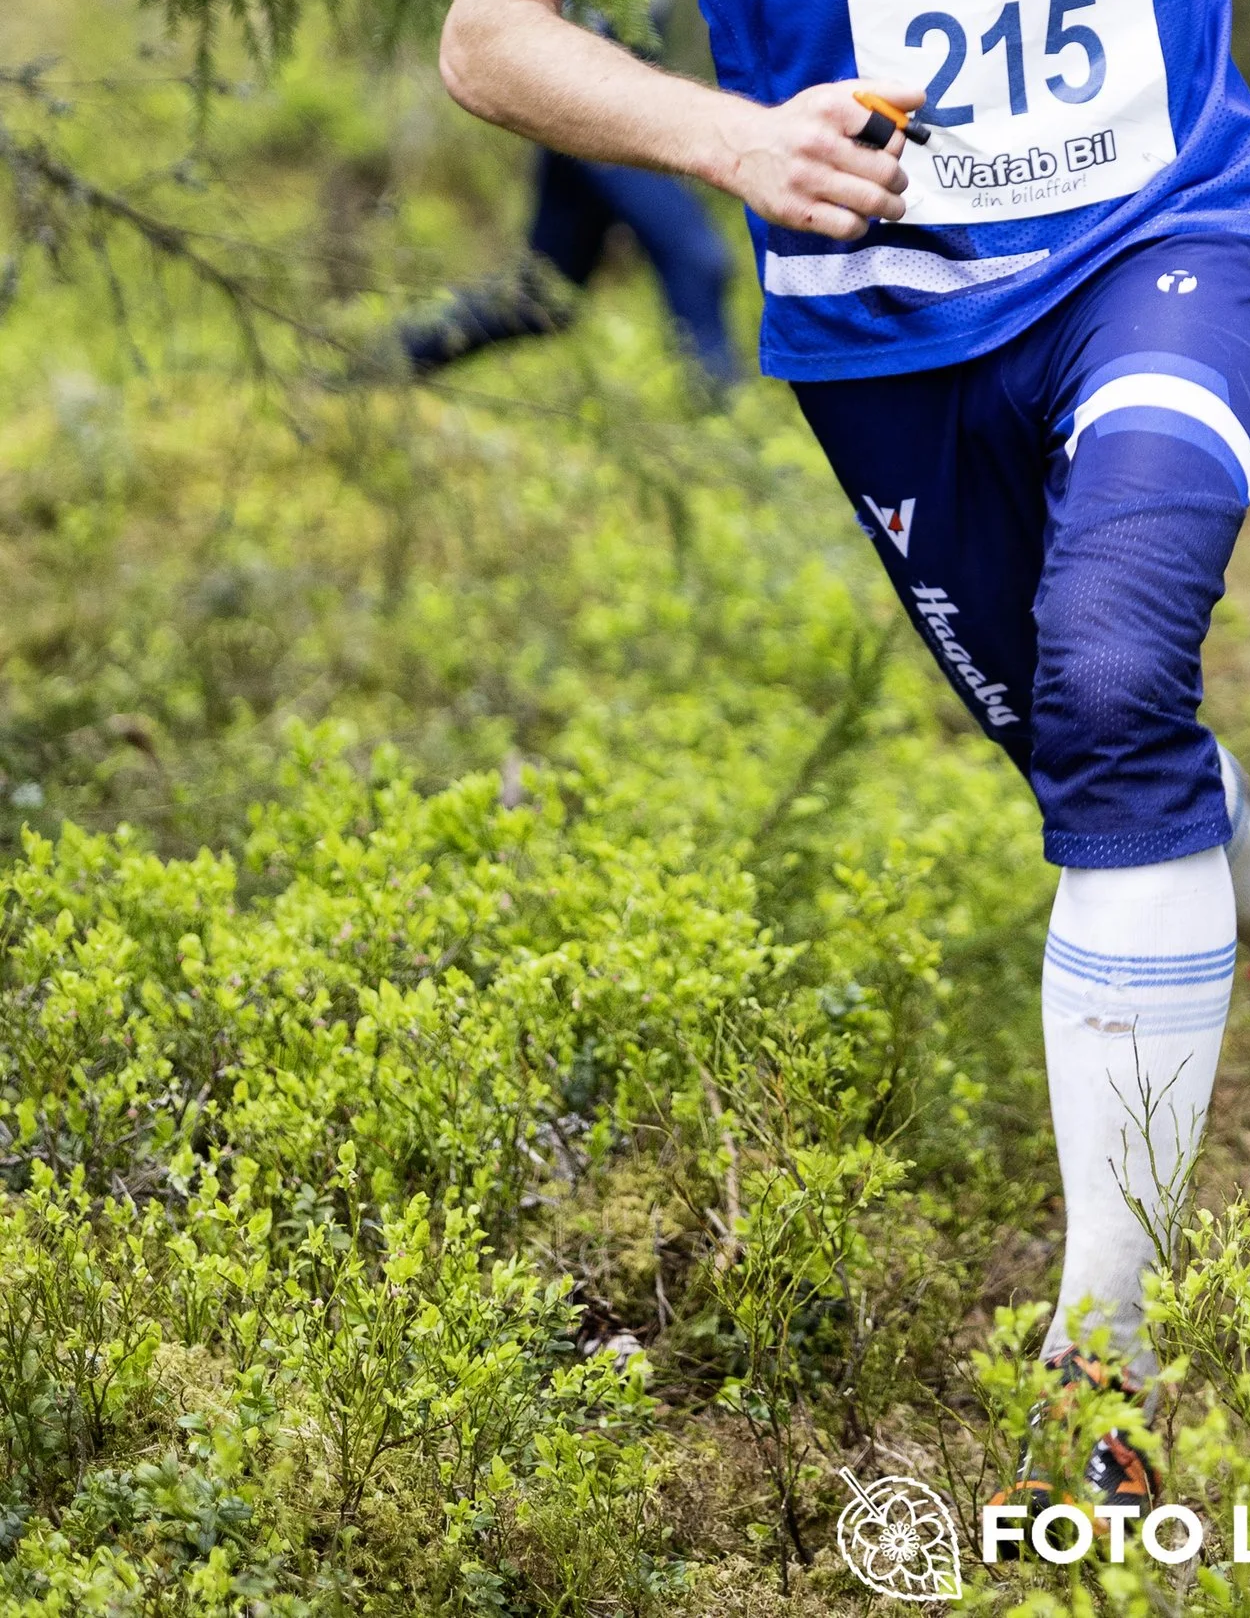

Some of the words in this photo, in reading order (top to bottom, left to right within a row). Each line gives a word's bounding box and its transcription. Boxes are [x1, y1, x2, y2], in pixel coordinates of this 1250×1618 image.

[933, 147, 1057, 189] Wafab
[1064, 129, 1117, 172] Bil
[971, 192, 1003, 208] din
[1011, 173, 1088, 205] bilaffar!
[910, 581, 1020, 726] Hagaby
